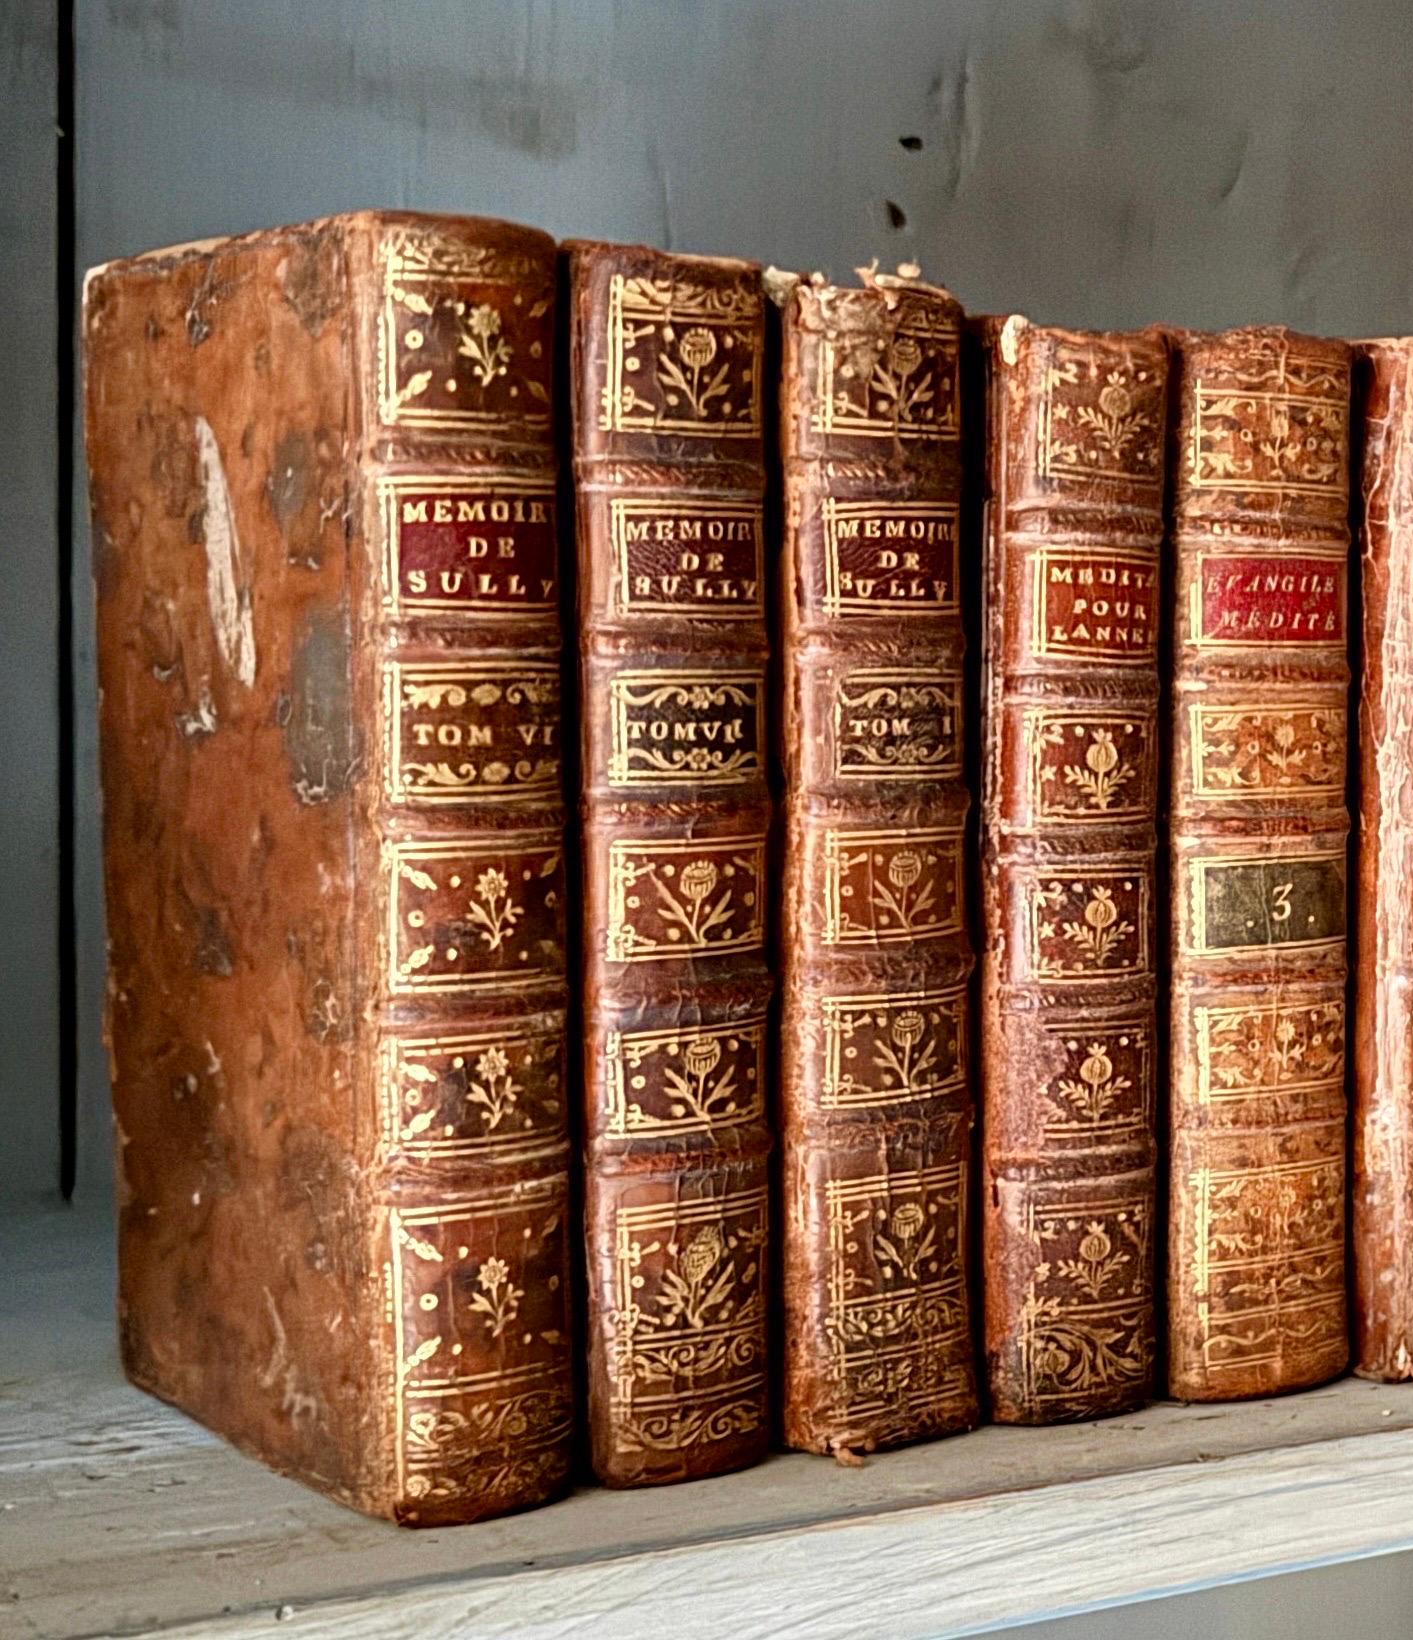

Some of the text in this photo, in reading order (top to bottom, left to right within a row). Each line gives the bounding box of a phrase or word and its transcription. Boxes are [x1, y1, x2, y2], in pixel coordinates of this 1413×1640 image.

[403, 500, 547, 523] MEMOIR
[627, 520, 751, 541] MEMOIR
[467, 537, 515, 558] DE
[681, 552, 724, 572] DE
[877, 550, 920, 571] DE
[407, 570, 553, 598] SULLY
[635, 575, 757, 599] SULLY
[1073, 599, 1147, 620] POUR
[413, 724, 492, 746] TOM
[849, 718, 911, 736] TOM
